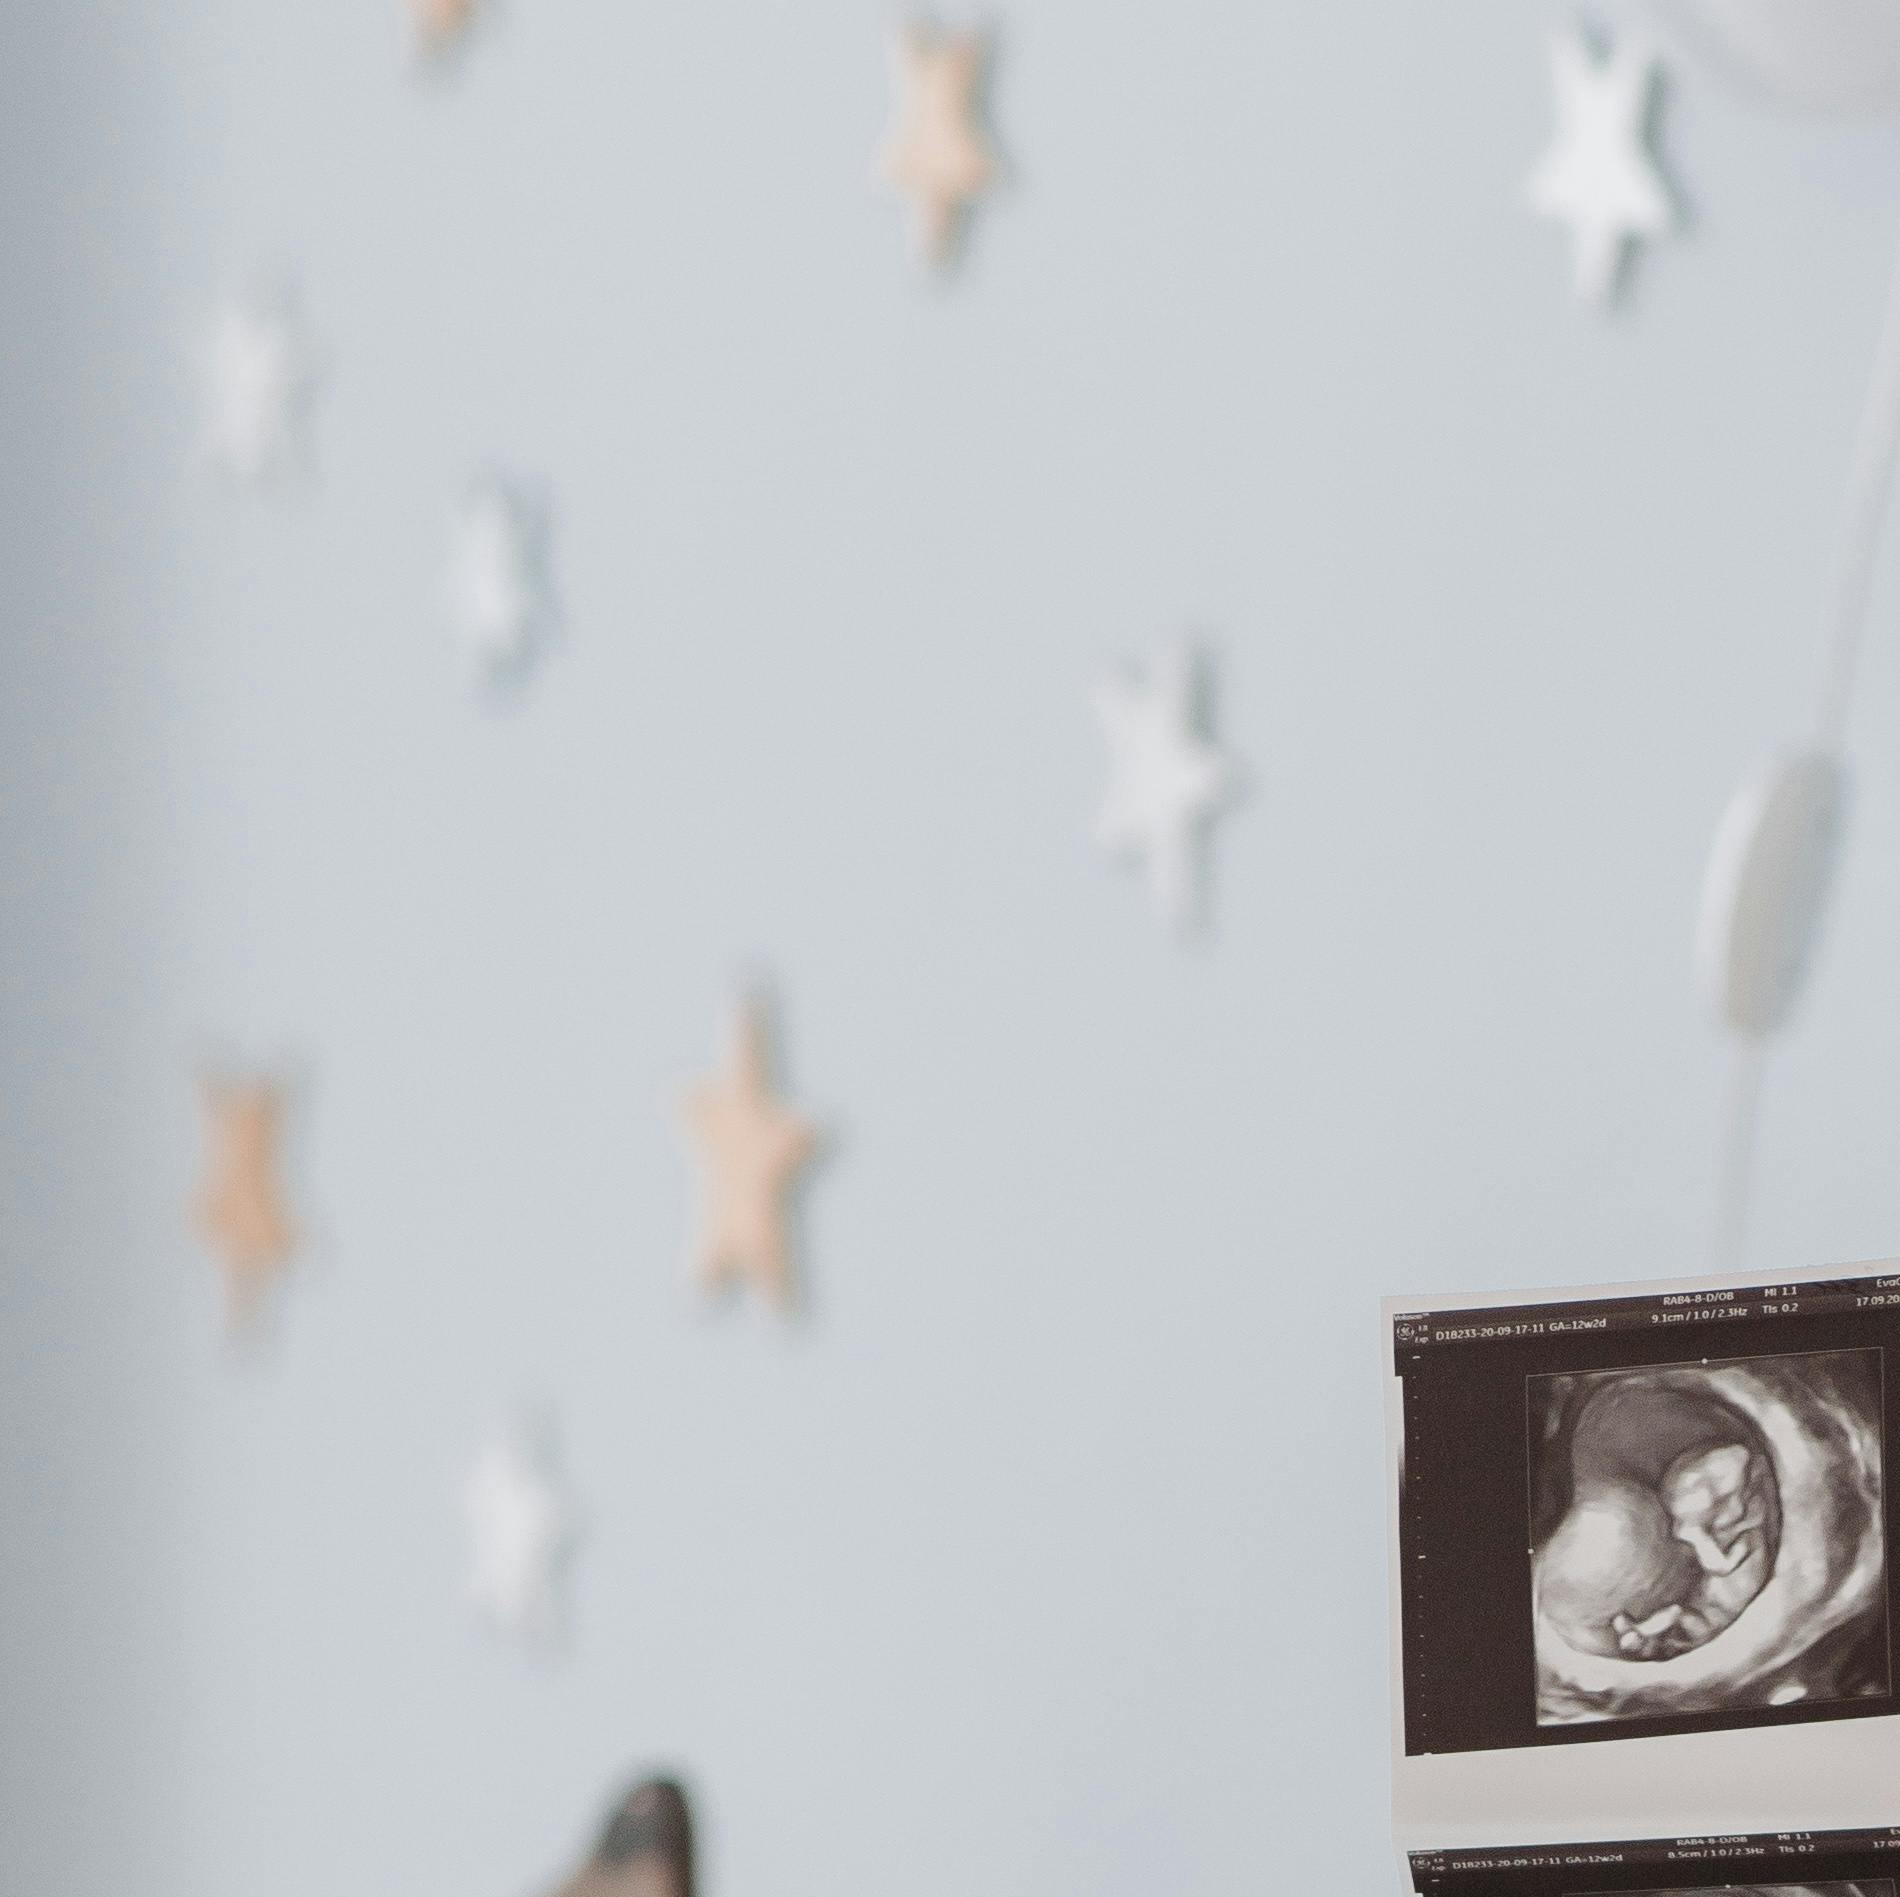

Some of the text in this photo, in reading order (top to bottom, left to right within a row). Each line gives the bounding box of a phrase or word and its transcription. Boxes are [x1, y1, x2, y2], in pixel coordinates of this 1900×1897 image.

[1781, 1302, 1798, 1313] 0.2
[1436, 1318, 1607, 1341] D18233-20-09-17-11 GA=12w2d
